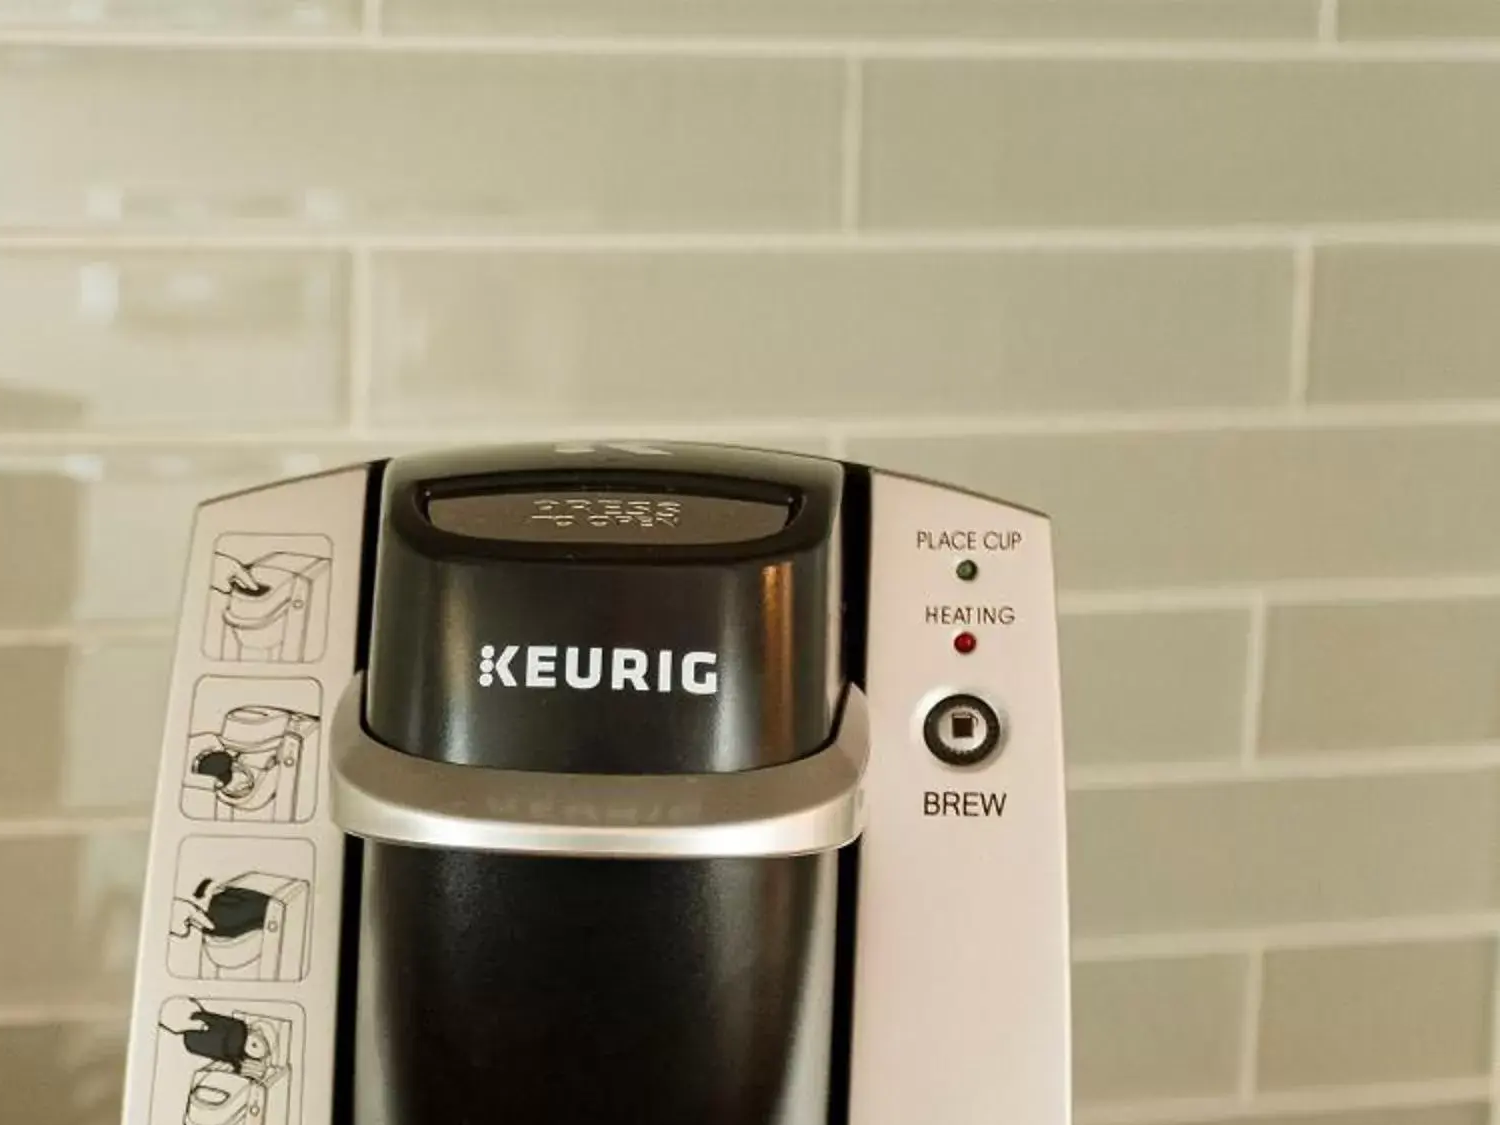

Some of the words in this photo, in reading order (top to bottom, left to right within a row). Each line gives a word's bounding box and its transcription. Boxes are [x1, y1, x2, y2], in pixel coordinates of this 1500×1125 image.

[916, 530, 977, 551] PLACE
[983, 530, 1022, 551] CUP
[924, 605, 1016, 625] HEATING
[478, 644, 718, 695] KEURIG
[923, 790, 1008, 817] BREW
